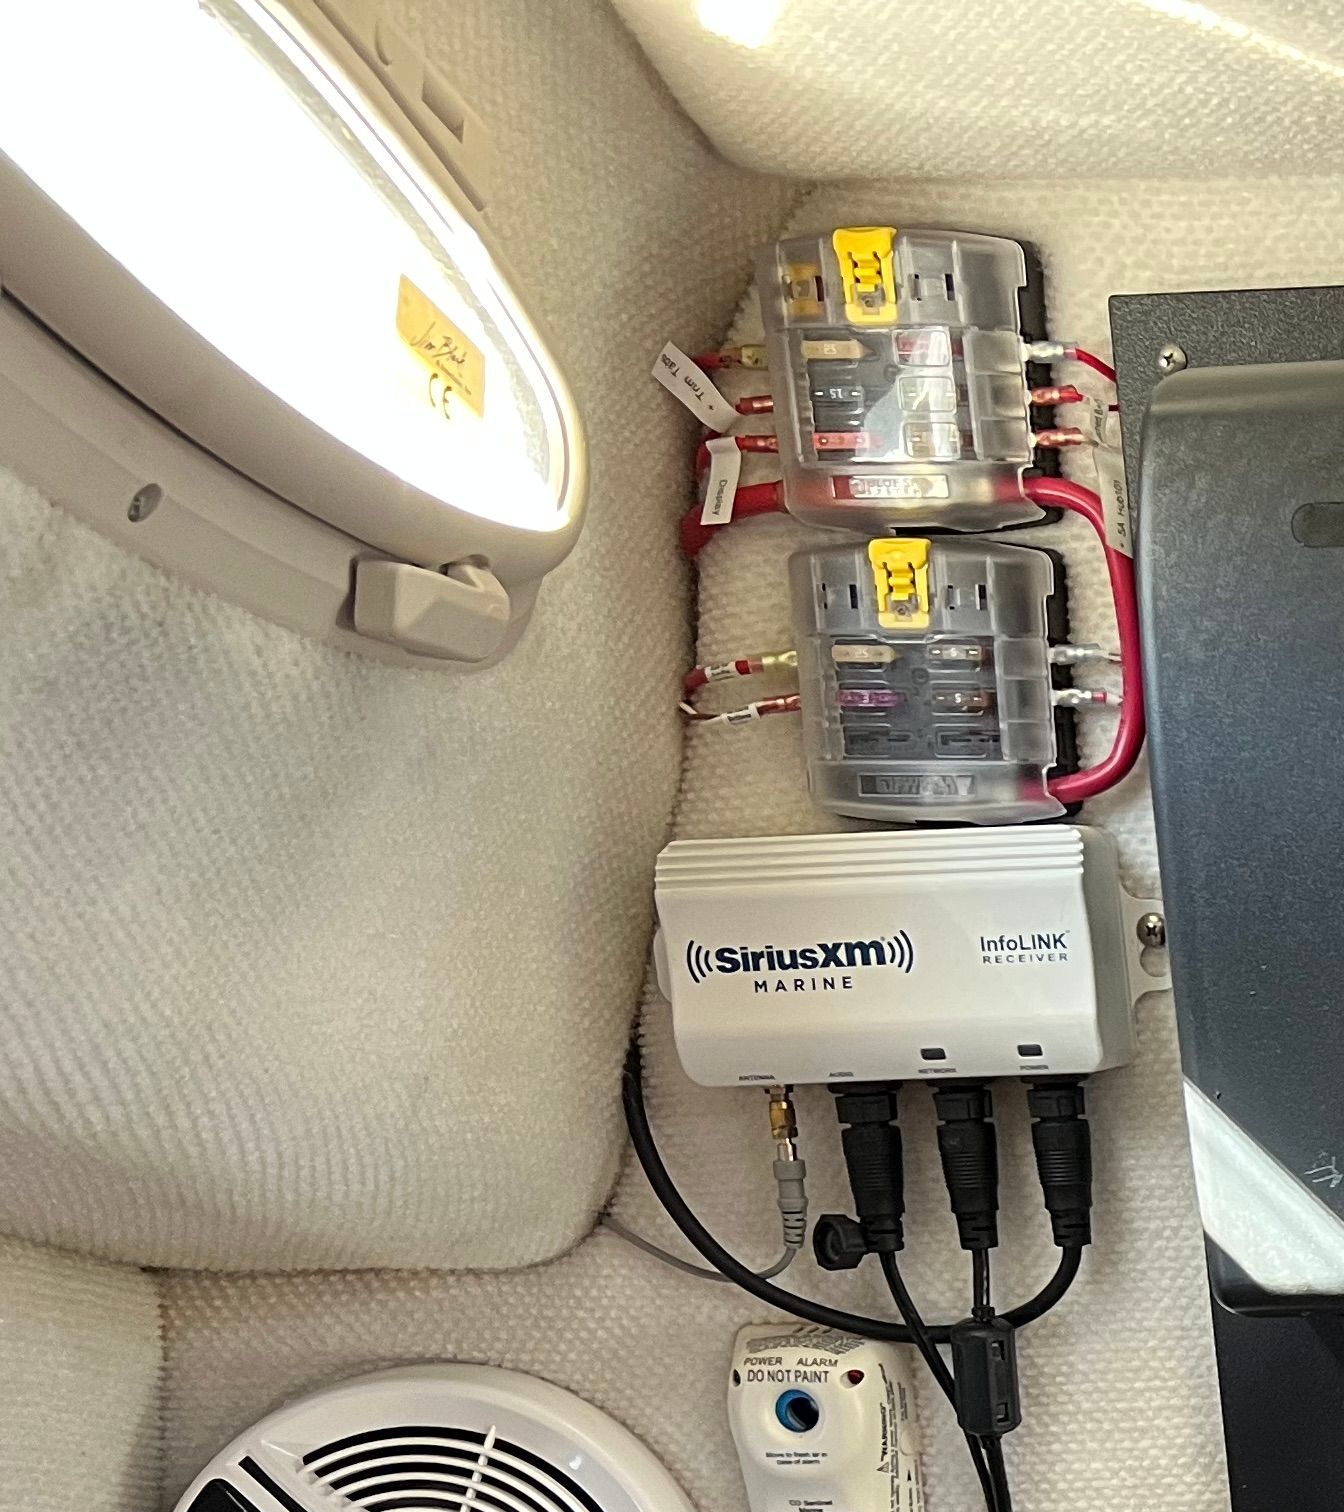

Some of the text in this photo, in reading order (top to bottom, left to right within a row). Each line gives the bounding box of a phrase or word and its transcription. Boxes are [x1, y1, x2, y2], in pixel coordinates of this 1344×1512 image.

[980, 931, 1068, 953] InfoLINK
[982, 953, 1068, 964] RECEIVER
[754, 976, 853, 994] MARINE
[743, 1356, 839, 1368] POWER ALARM
[747, 1369, 830, 1383] DO NOT PAINT
